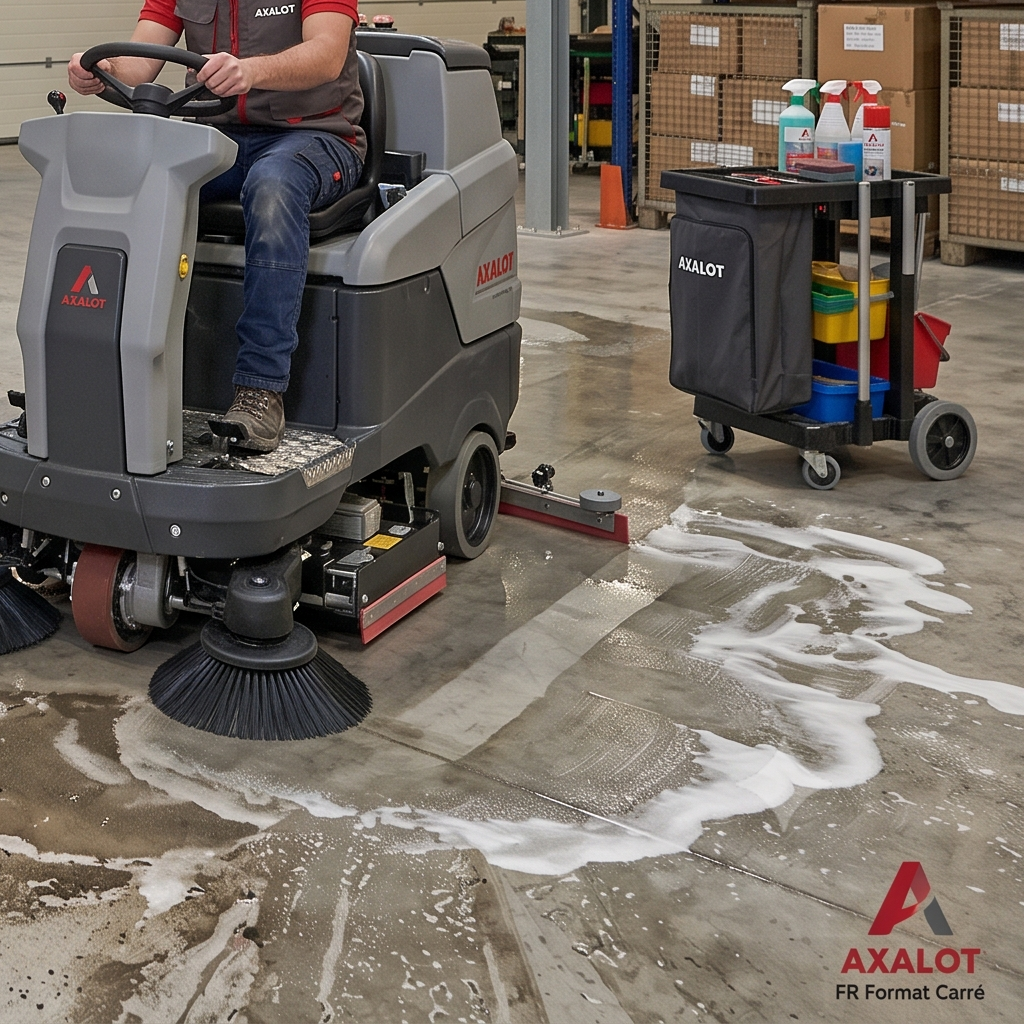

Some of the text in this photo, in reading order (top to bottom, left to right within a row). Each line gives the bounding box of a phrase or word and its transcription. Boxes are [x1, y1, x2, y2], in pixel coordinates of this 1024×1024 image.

[254, 4, 296, 18] AXALOT
[476, 251, 514, 288] AXALOT
[678, 256, 725, 278] AXALOT
[61, 295, 107, 309] AXALOT
